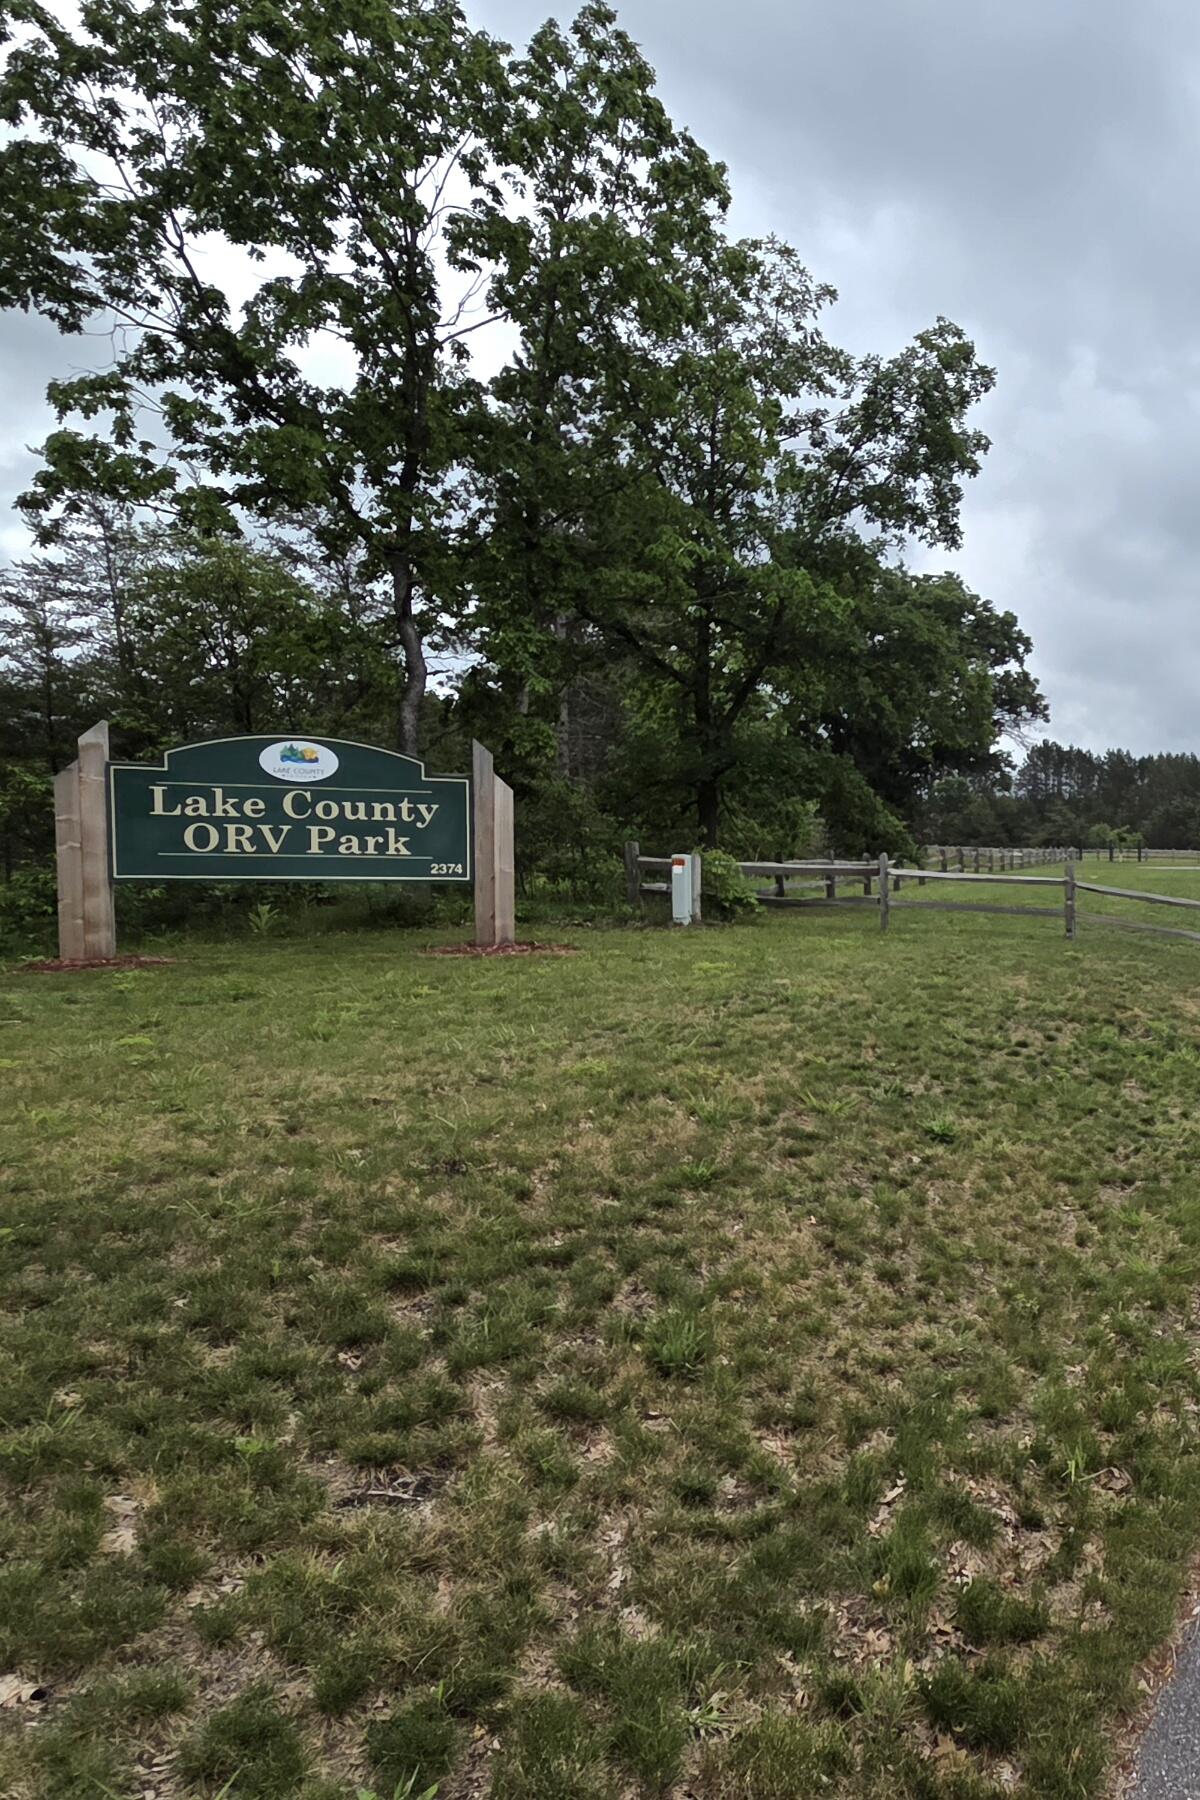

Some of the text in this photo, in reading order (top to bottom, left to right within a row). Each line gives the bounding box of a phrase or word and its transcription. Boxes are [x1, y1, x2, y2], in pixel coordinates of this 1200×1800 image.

[149, 786, 439, 828] Lake County
[183, 822, 411, 856] ORV Park
[430, 863, 463, 874] 2374
